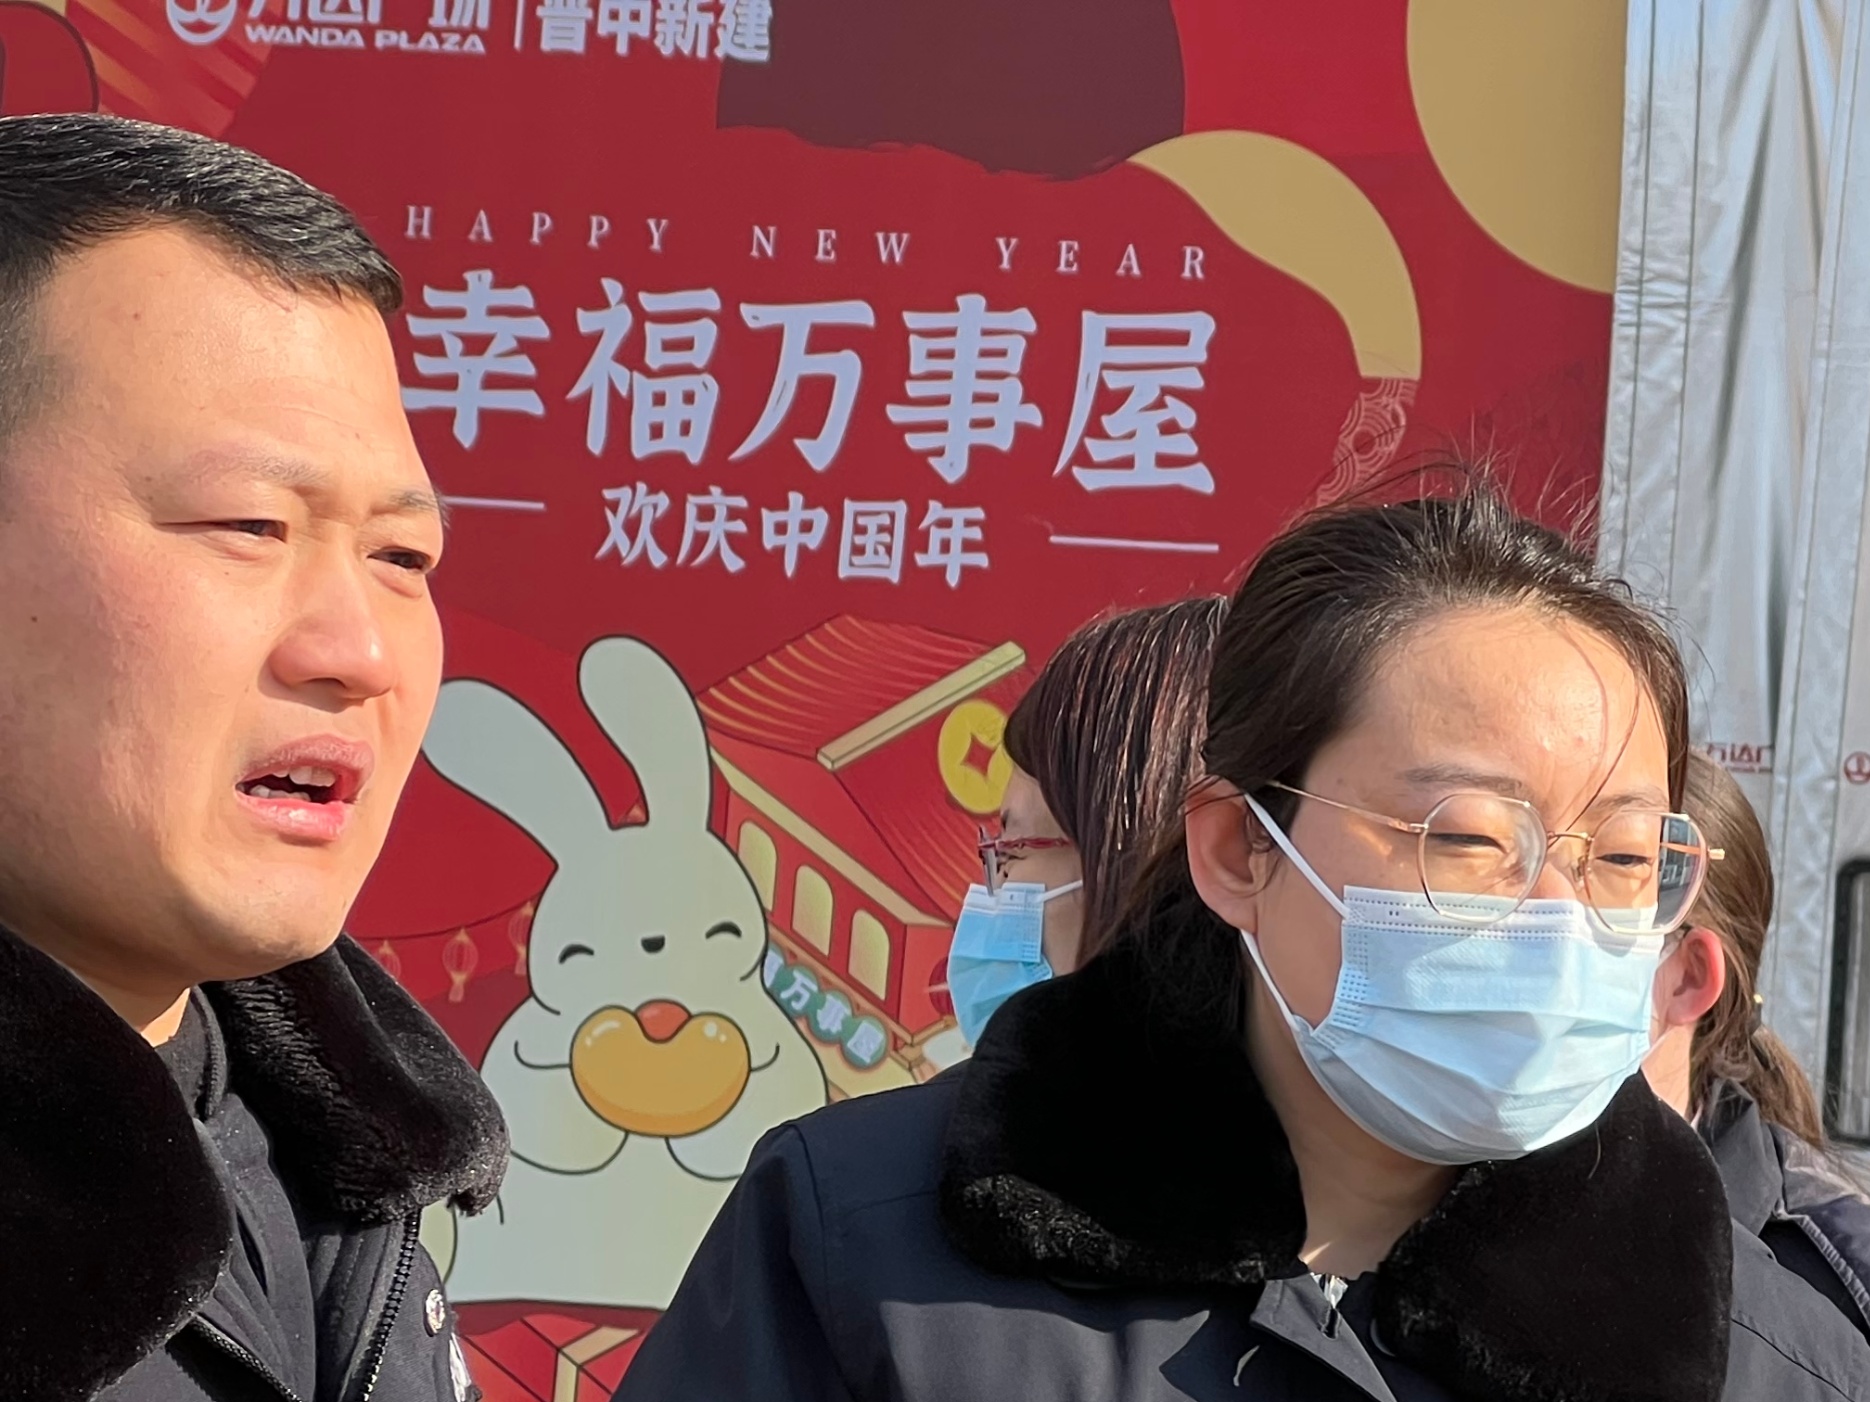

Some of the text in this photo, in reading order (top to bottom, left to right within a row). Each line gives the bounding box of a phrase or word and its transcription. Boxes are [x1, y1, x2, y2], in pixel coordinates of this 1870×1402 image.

[245, 24, 487, 55] WANDA PLAZA
[404, 205, 1206, 280] HAPPY NEW YEAR
[402, 268, 1217, 495] 幸福万事屋
[594, 481, 990, 589] 欢庆中国年
